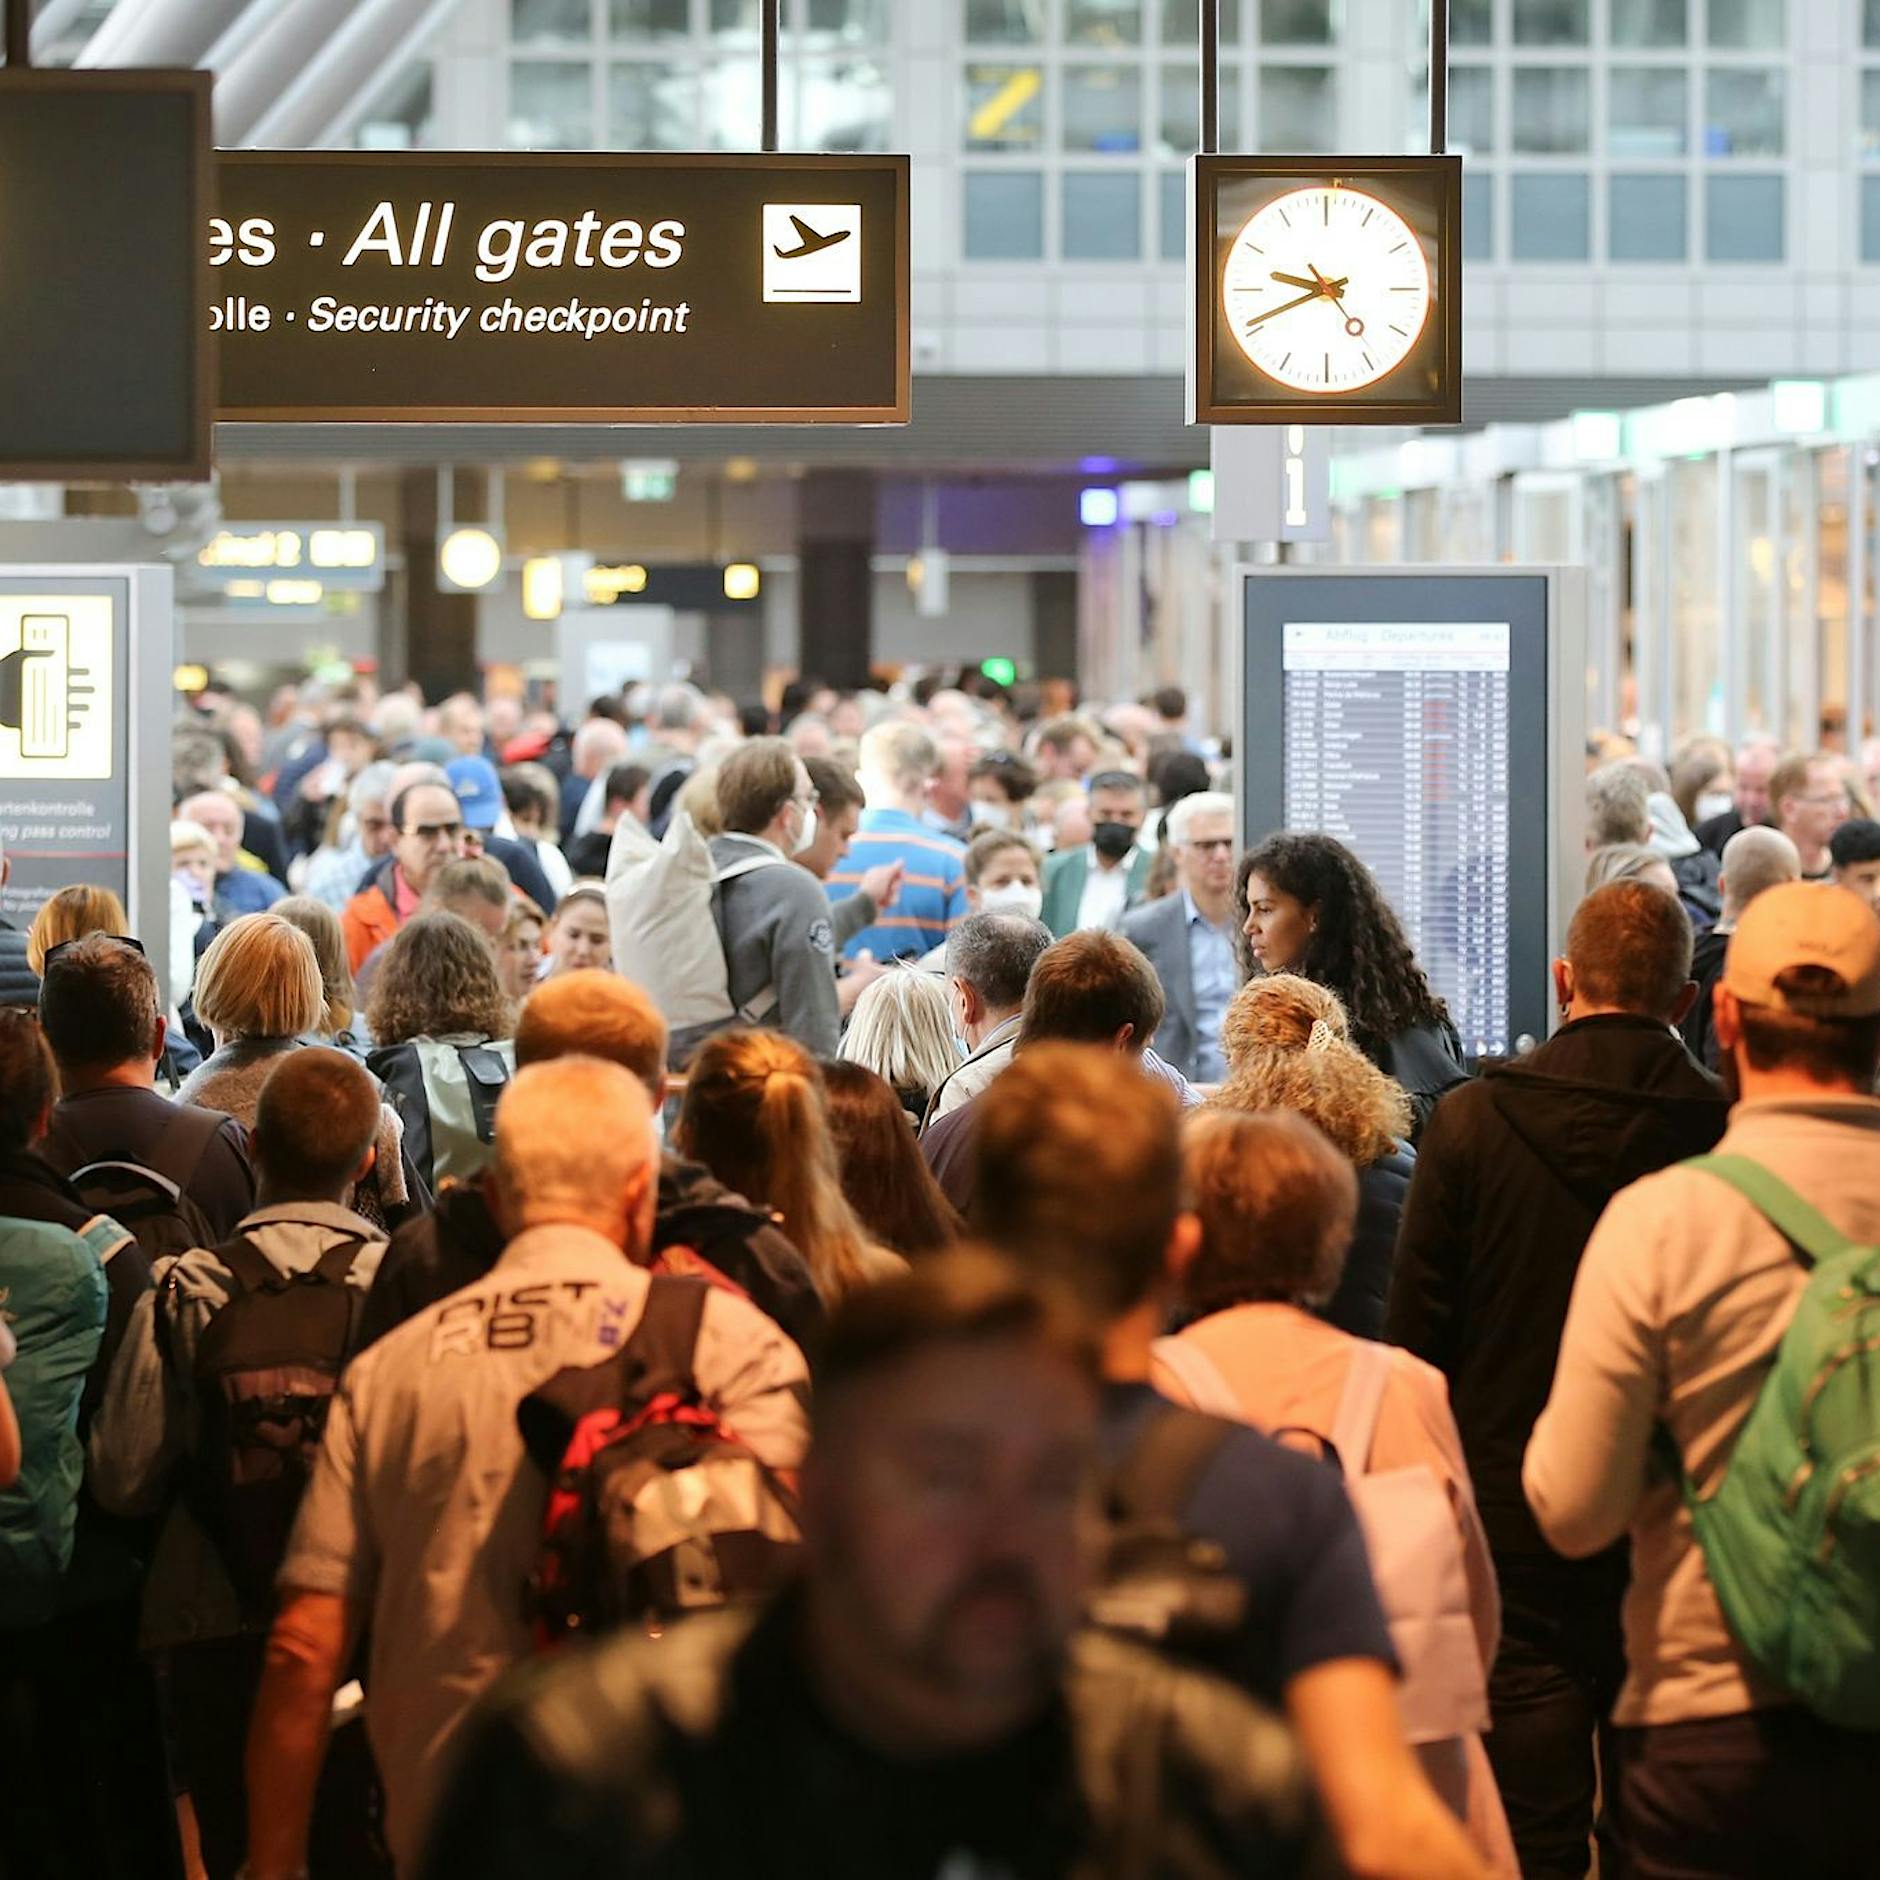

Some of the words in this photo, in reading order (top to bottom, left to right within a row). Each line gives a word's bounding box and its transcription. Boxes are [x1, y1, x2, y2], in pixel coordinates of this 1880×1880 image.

[341, 201, 456, 267] All
[474, 208, 687, 283] gates
[307, 296, 472, 340] Security
[479, 297, 691, 340] checkpoint
[58, 822, 112, 839] control
